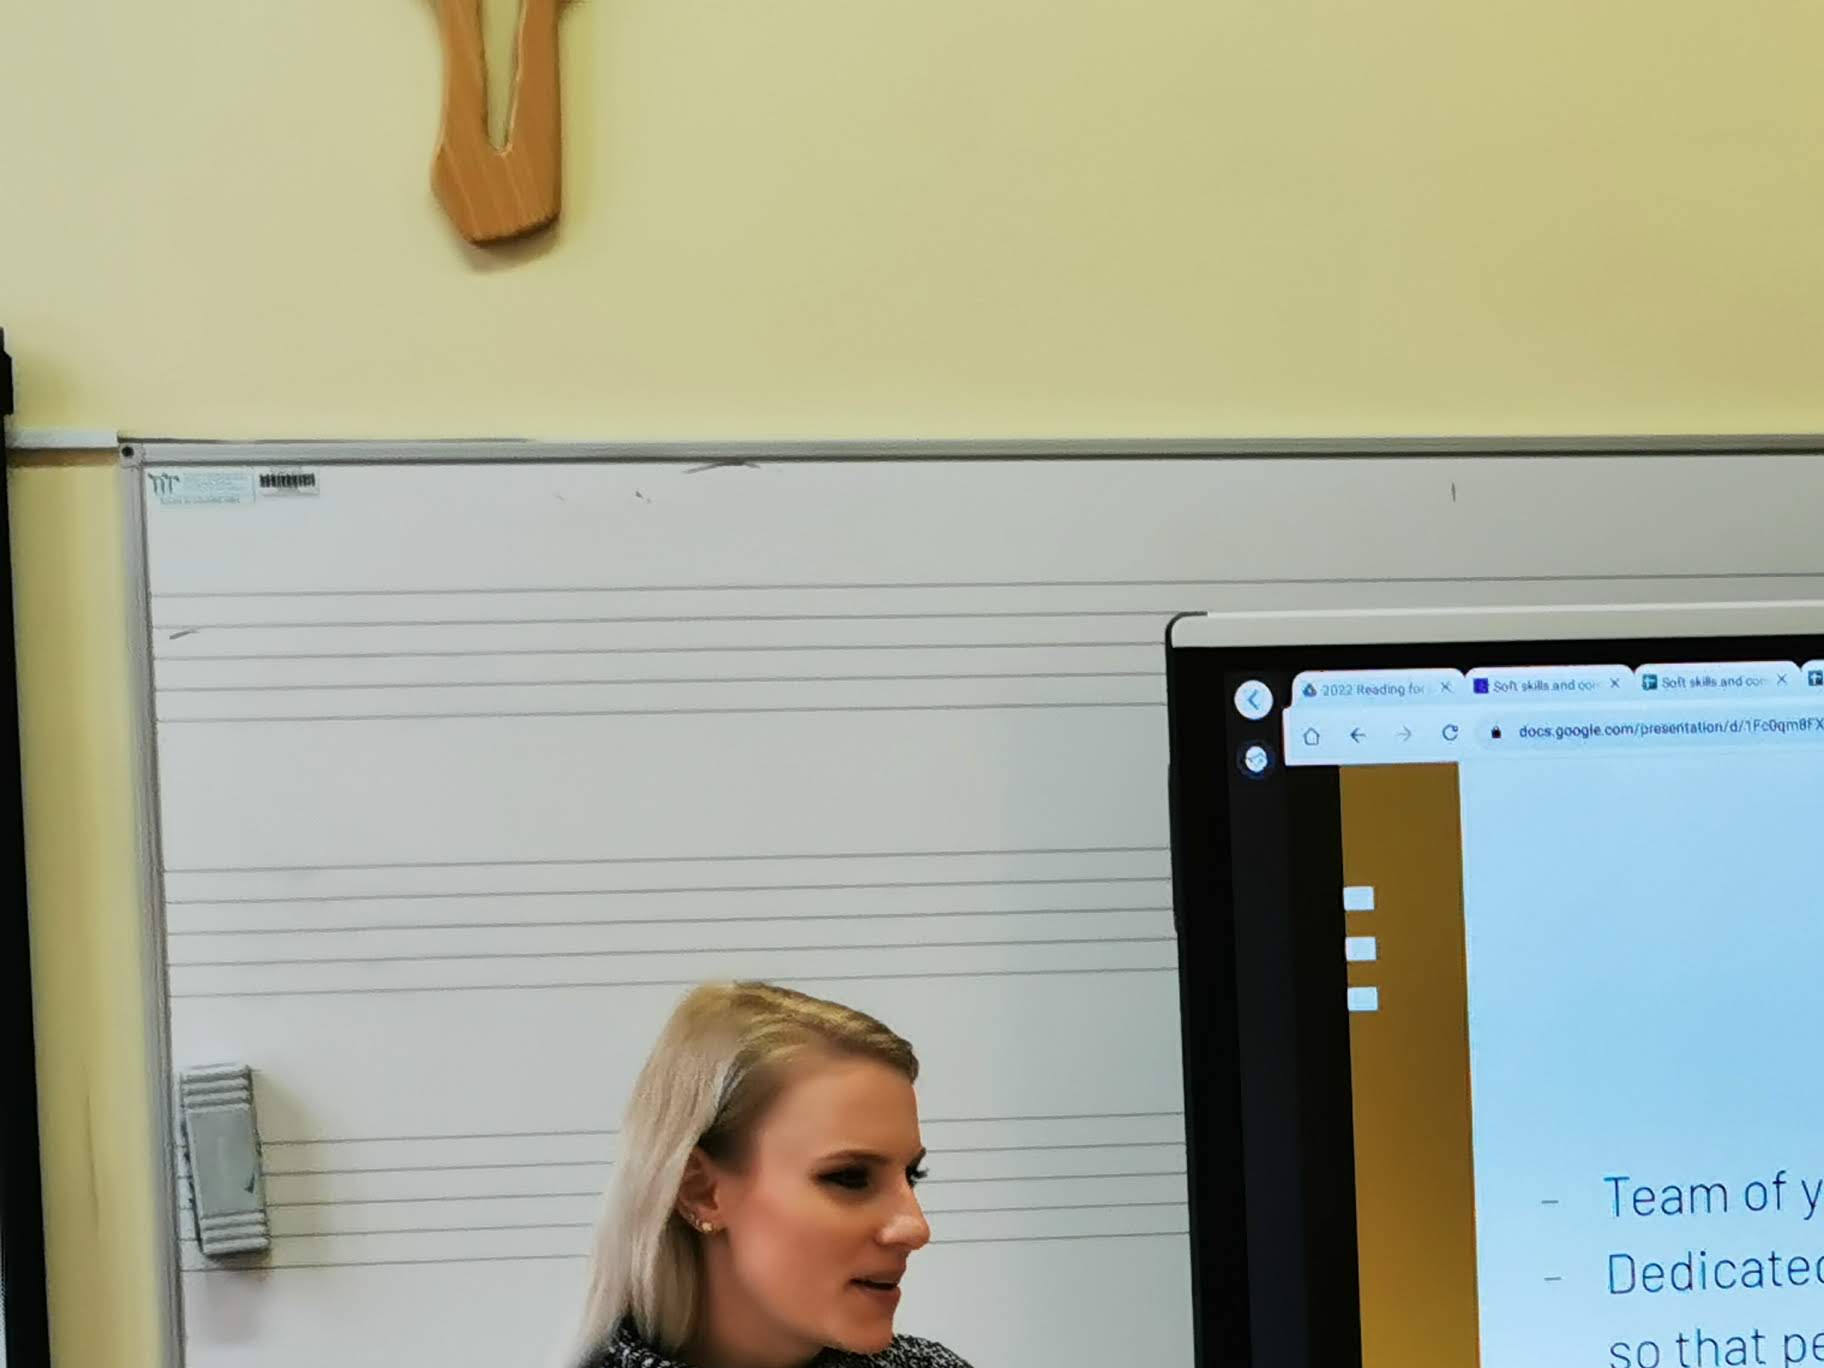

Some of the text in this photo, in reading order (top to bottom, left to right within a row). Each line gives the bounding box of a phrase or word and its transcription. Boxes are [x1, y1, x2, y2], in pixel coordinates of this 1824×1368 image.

[1493, 680, 1518, 692] Soft
[1521, 680, 1549, 691] skills
[1552, 679, 1574, 691] and
[1662, 676, 1686, 688] Soft
[1690, 676, 1717, 688] skills
[1720, 675, 1742, 687] and
[1322, 684, 1354, 697] 2022
[1356, 683, 1405, 698] Reading
[1604, 1174, 1729, 1218] Team
[1744, 1170, 1787, 1211] of
[1675, 1326, 1767, 1368] that
